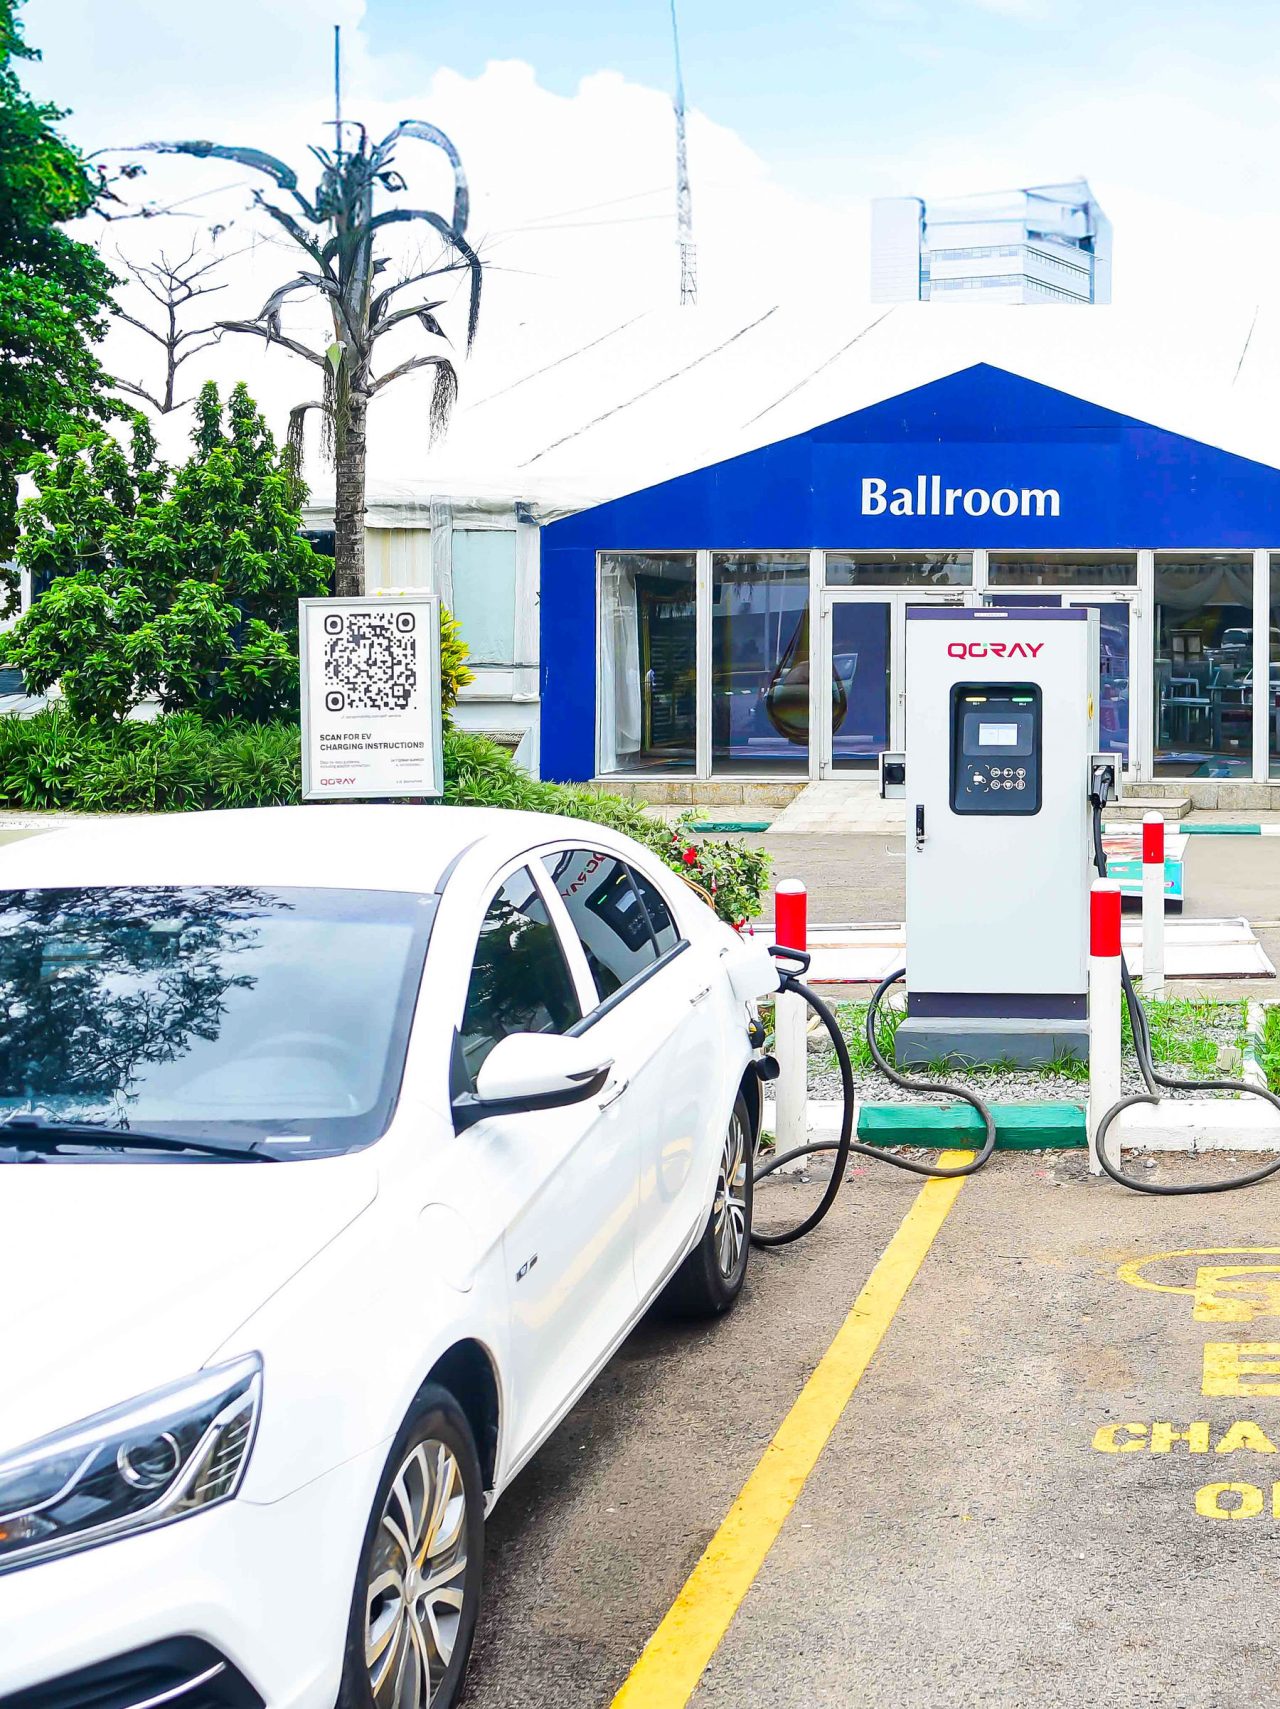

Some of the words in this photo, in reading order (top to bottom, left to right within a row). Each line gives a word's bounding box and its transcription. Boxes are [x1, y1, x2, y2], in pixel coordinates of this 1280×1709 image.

[861, 475, 1060, 517] Ballroom
[320, 743, 364, 751] CHARGING
[364, 741, 425, 750] INSTRUCTIONS
